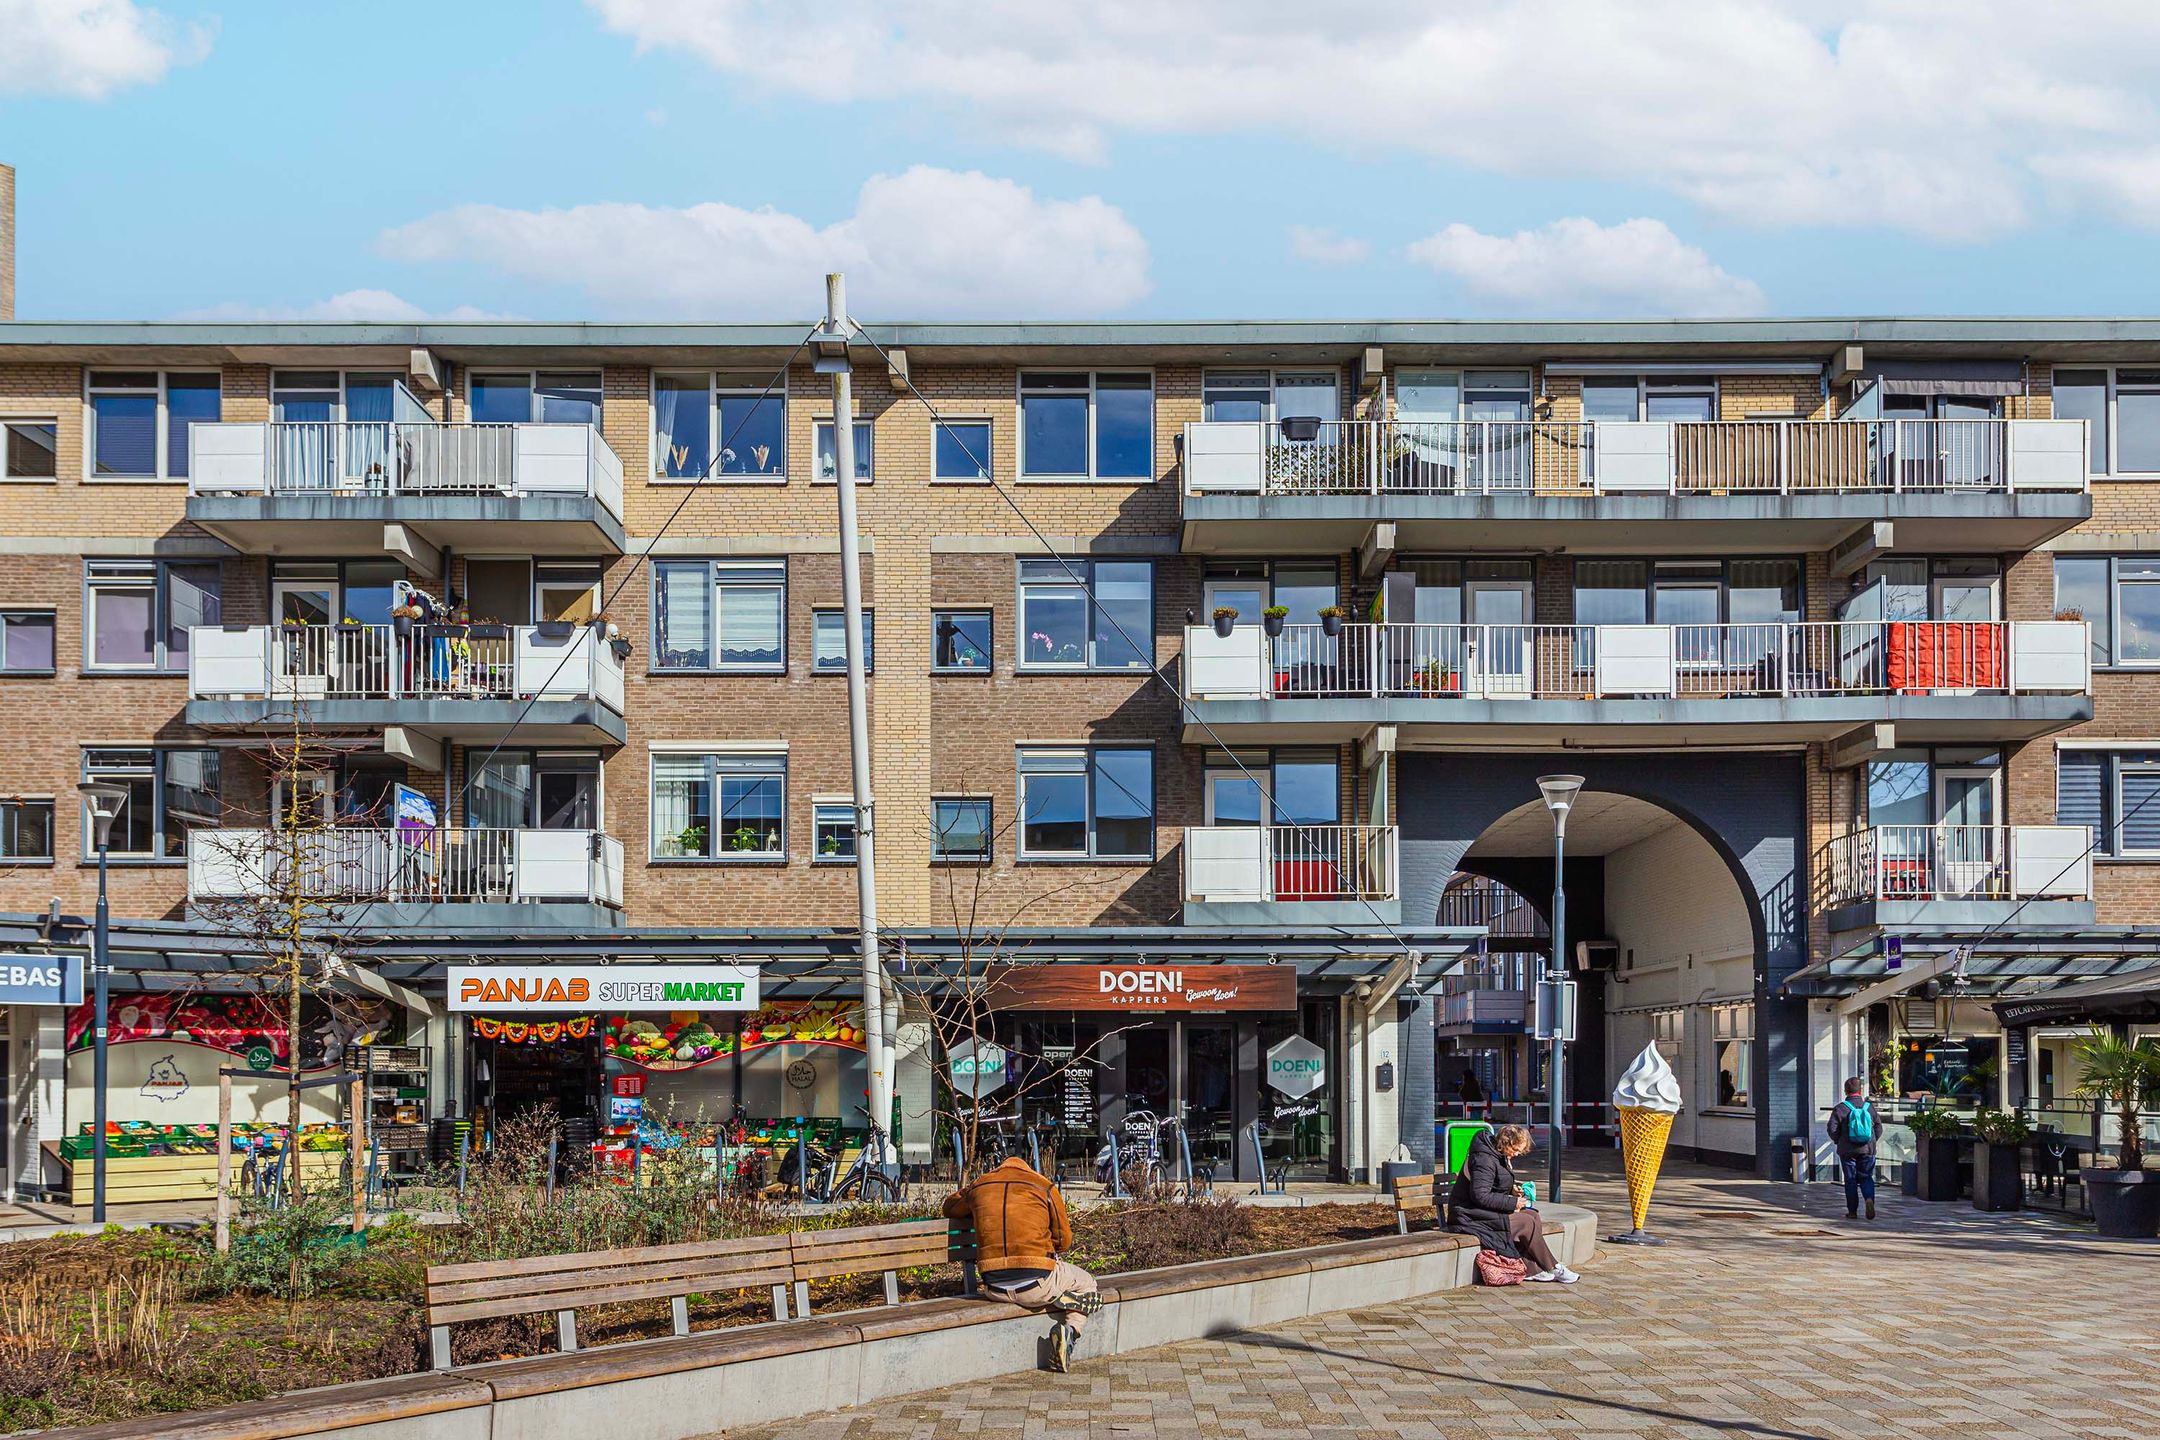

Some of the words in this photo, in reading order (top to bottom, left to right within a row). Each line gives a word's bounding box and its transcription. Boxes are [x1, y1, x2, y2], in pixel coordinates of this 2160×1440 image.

[1099, 970, 1183, 993] DOEN!
[461, 977, 590, 1002] PANJAB
[598, 982, 745, 1001] SUPERMARKET
[1185, 987, 1217, 1003] Gewoon
[1214, 986, 1239, 1001] doen!
[1112, 996, 1168, 1004] KAPPERS
[1043, 1051, 1073, 1060] open
[1272, 1060, 1320, 1072] DOEN!
[1064, 1069, 1093, 1077] DOEN!
[1274, 1106, 1302, 1119] Gewoon
[1298, 1104, 1319, 1117] doen!
[1125, 1122, 1150, 1130] DOEN
